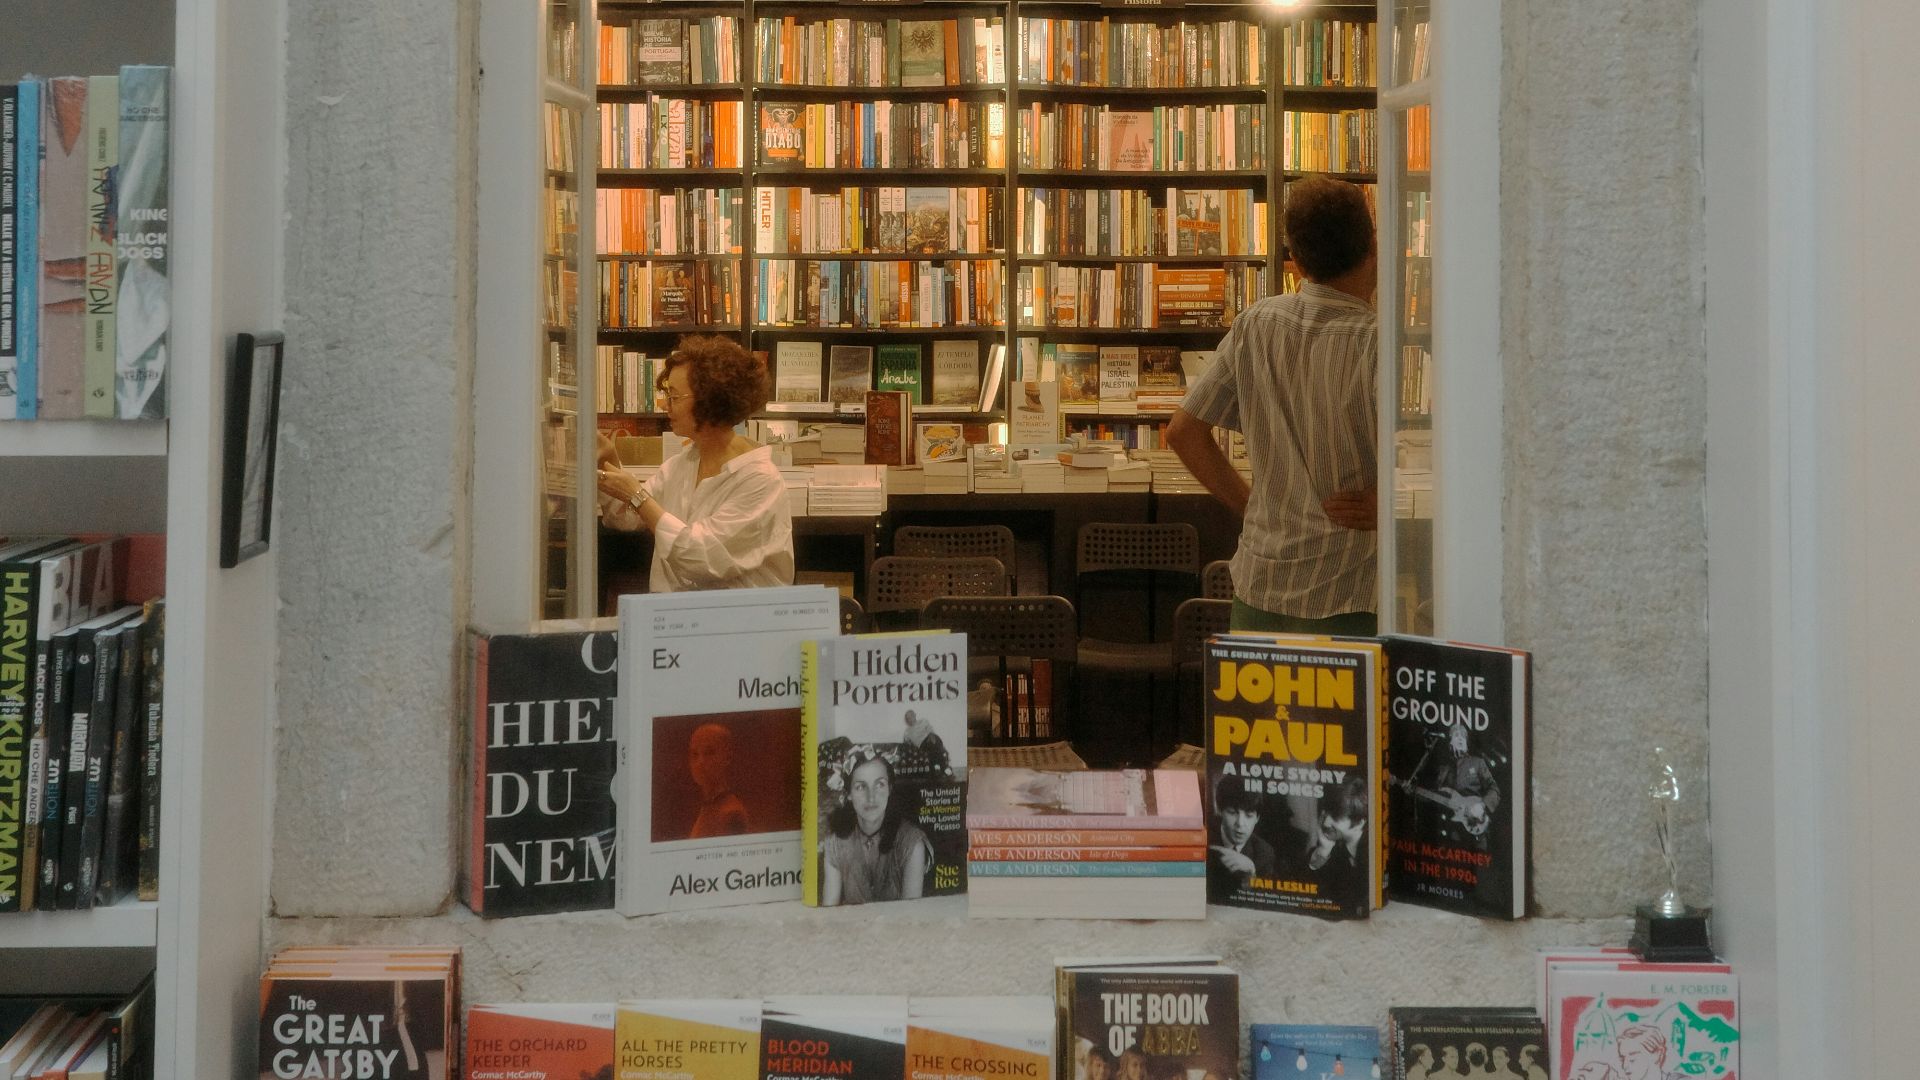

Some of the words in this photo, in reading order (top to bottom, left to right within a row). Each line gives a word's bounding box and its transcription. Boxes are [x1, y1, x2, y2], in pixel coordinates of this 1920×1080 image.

[762, 191, 772, 229] HITLER
[117, 232, 168, 246] BLACK
[1107, 370, 1130, 378] ISRAEL
[1101, 380, 1137, 389] PALESTINA
[0, 571, 28, 702] HARVEY
[652, 648, 680, 670] Ex
[852, 643, 960, 677] Hidden
[1211, 649, 1229, 659] THE
[1230, 650, 1268, 661] SUNDAY
[1271, 653, 1298, 663] TIMES
[1300, 655, 1358, 666] BESTSELLER
[35, 654, 47, 691] BLACK
[831, 675, 961, 706] Portraits
[1213, 661, 1355, 711] JOHN
[1396, 665, 1437, 693] OFF
[1445, 672, 1485, 701] THE
[33, 692, 44, 726] DOGS
[1275, 704, 1290, 721] &
[1392, 696, 1489, 732] GROUND
[487, 697, 618, 748] HIE
[1213, 715, 1358, 766] PAUL
[29, 761, 39, 785] CHE
[1223, 761, 1236, 776] A
[1241, 763, 1284, 779] LOVE
[1287, 767, 1346, 785] STORY
[486, 768, 578, 819] DU
[920, 789, 934, 799] The
[935, 786, 961, 798] Untold
[1244, 779, 1263, 793] IN
[1266, 781, 1325, 799] SONGS
[0, 716, 23, 900] KURTZMAN
[920, 806, 931, 815] Six
[932, 804, 961, 815] Women
[925, 796, 951, 807] Stories
[952, 796, 961, 805] of
[918, 815, 932, 824] Who
[934, 813, 961, 824] Loved
[934, 822, 961, 832] Picasso
[968, 816, 998, 828] WES
[1002, 816, 1076, 828] ANDERSON
[973, 833, 1001, 845] WES
[1006, 833, 1081, 845] ANDERSON
[973, 849, 1001, 860] WES
[1006, 849, 1081, 860] ANDERSON
[1392, 840, 1417, 854] PAUL
[1422, 842, 1492, 866] McCARTNEY
[935, 864, 960, 877] Sue
[971, 863, 999, 875] WES
[1005, 863, 1080, 875] ANDERSON
[1403, 860, 1417, 872] IN
[1420, 862, 1441, 877] THE
[1445, 865, 1478, 886] 1990s
[669, 870, 719, 897] Alex
[934, 876, 960, 890] Roe
[1249, 875, 1275, 889] IAN
[1277, 879, 1319, 895] LESLIE
[1416, 883, 1427, 892] JR
[1428, 885, 1464, 900] MOORES
[1664, 984, 1677, 994] M.
[1680, 984, 1728, 995] FORSTER
[289, 995, 317, 1011] The
[1101, 993, 1143, 1025] THE
[1147, 993, 1209, 1025] BOOK
[273, 1014, 385, 1045] GREAT
[1423, 1026, 1474, 1034] INTERNATIONAL
[1515, 1027, 1543, 1035] AUTHOR
[473, 1039, 508, 1053] THE
[512, 1038, 587, 1053] ORCHARD
[621, 1040, 650, 1055] ALL
[655, 1040, 684, 1055] THE
[689, 1041, 748, 1056] PRETTY
[768, 1039, 830, 1056] BLOOD
[1108, 1026, 1137, 1057] OF
[1142, 1025, 1200, 1056] ABBA
[272, 1048, 400, 1080] GATSBY
[473, 1055, 531, 1068] KEEPER
[621, 1055, 683, 1069] HORSES
[767, 1058, 853, 1074] MERIDIAN
[912, 1053, 945, 1070] THE
[951, 1057, 1038, 1077] CROSSING
[471, 1070, 505, 1080] Cormac
[507, 1070, 547, 1080] McCarthy
[620, 1071, 653, 1080] Cormac
[654, 1071, 694, 1080] McCarthy
[911, 1071, 943, 1080] Cormac
[945, 1072, 986, 1080] McCarthy
